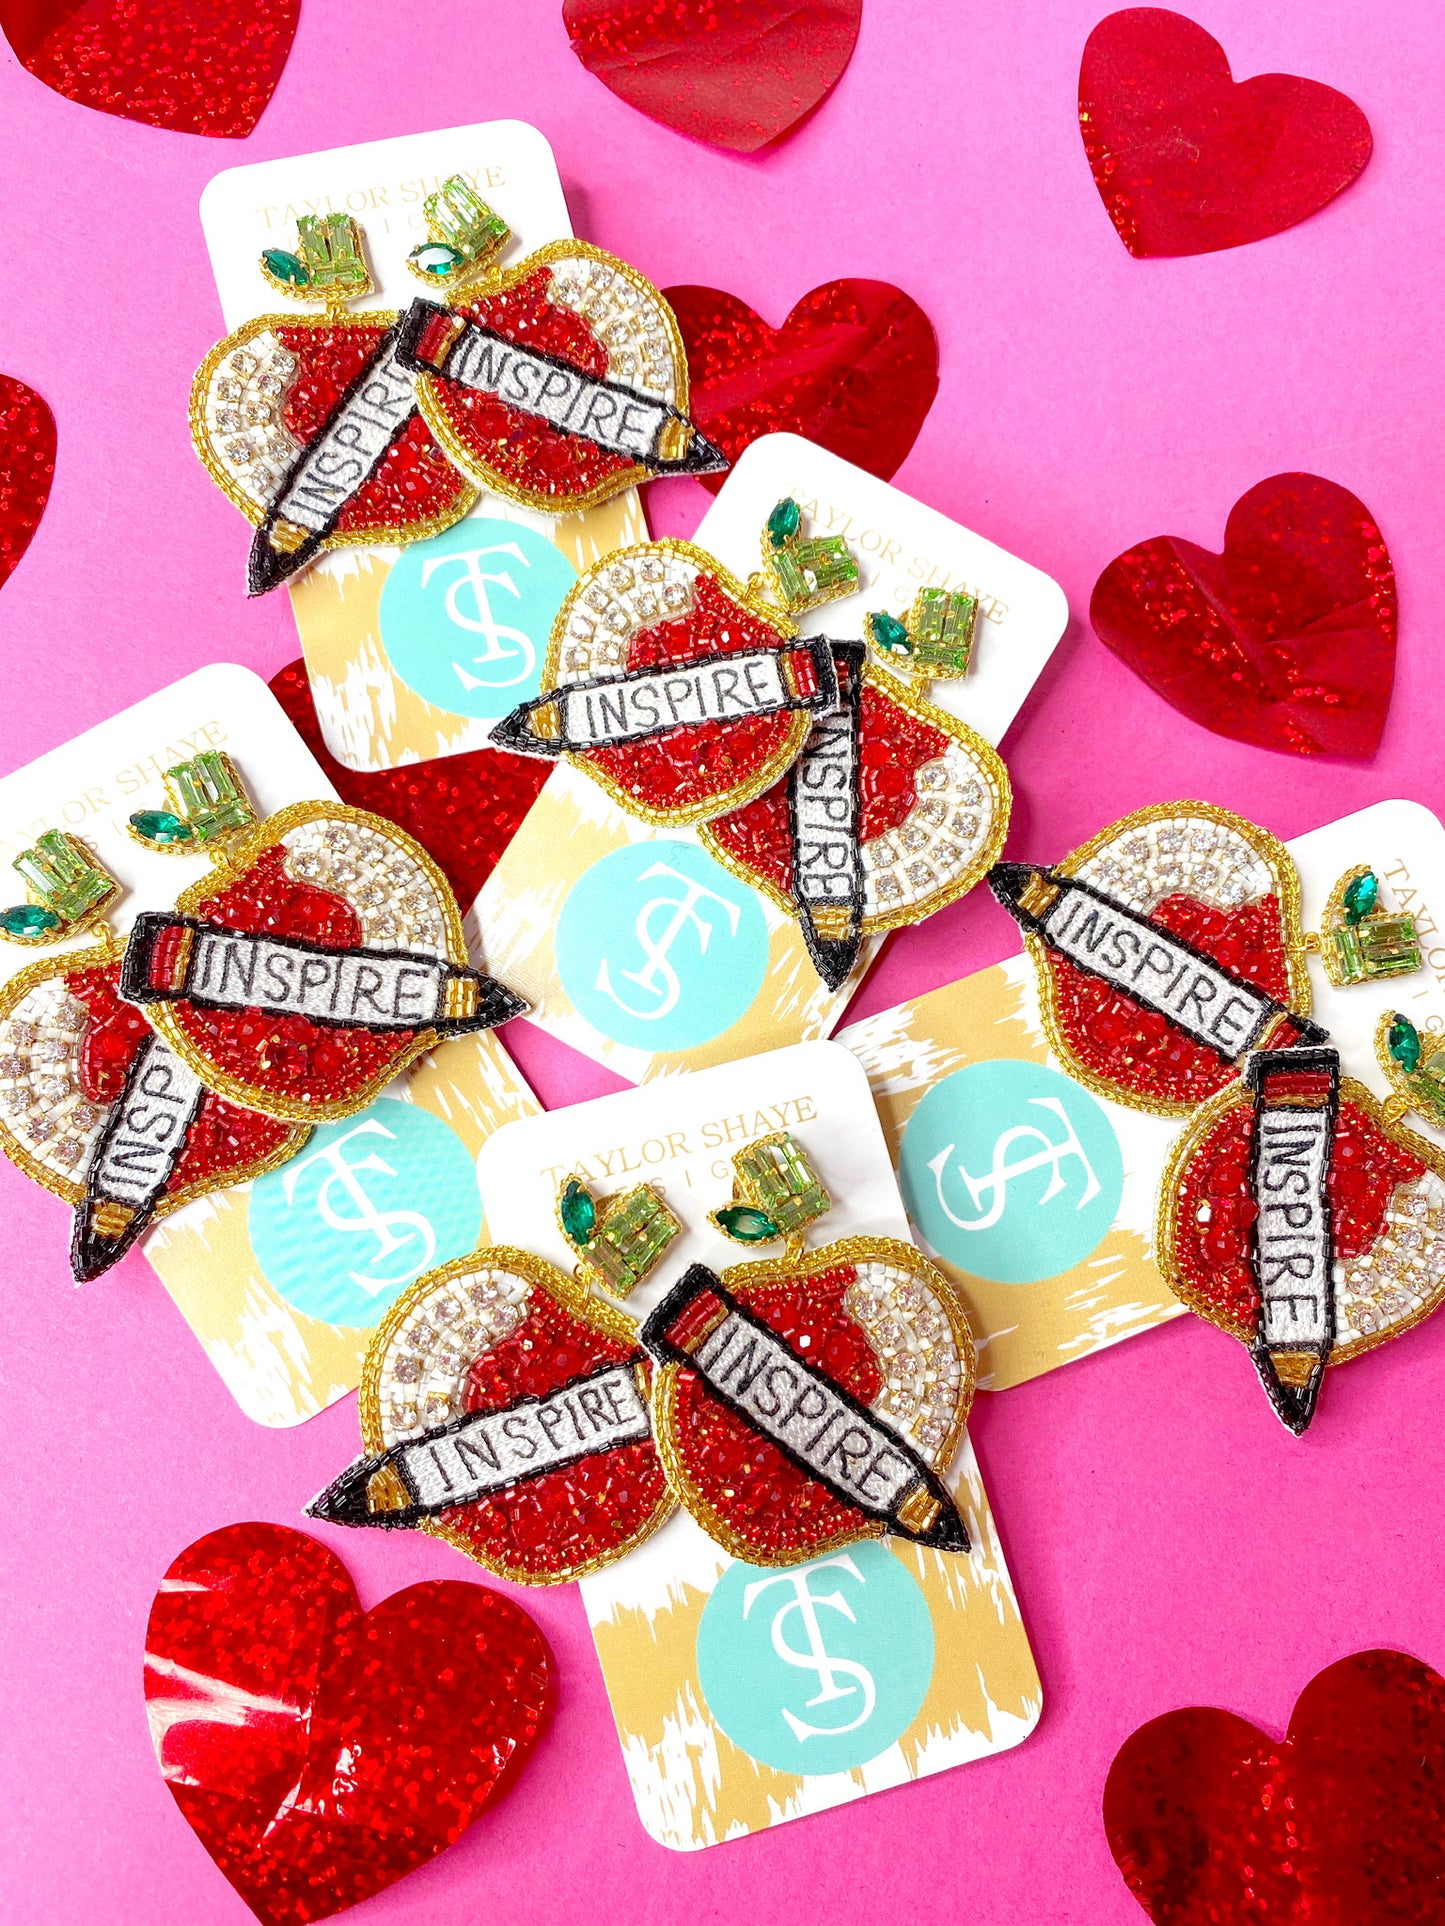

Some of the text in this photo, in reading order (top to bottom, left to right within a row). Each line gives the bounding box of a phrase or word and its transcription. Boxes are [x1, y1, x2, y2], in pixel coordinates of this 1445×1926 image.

[399, 165, 507, 204] SHYE
[456, 336, 651, 453] INSPIRE
[115, 720, 229, 796] SHAYE
[584, 661, 778, 739] INSPIRE
[198, 939, 431, 1023] INSPIRE
[1055, 897, 1257, 1047] INSPIRE
[1383, 857, 1445, 996] TAYLO
[101, 1045, 187, 1188] INSP
[539, 1131, 694, 1193] TAYLOR
[700, 1095, 819, 1149] SHAYE
[1263, 1122, 1324, 1325] INSPIRE
[427, 1377, 639, 1492] INSPIRE
[702, 1321, 905, 1504] INSPIRE
